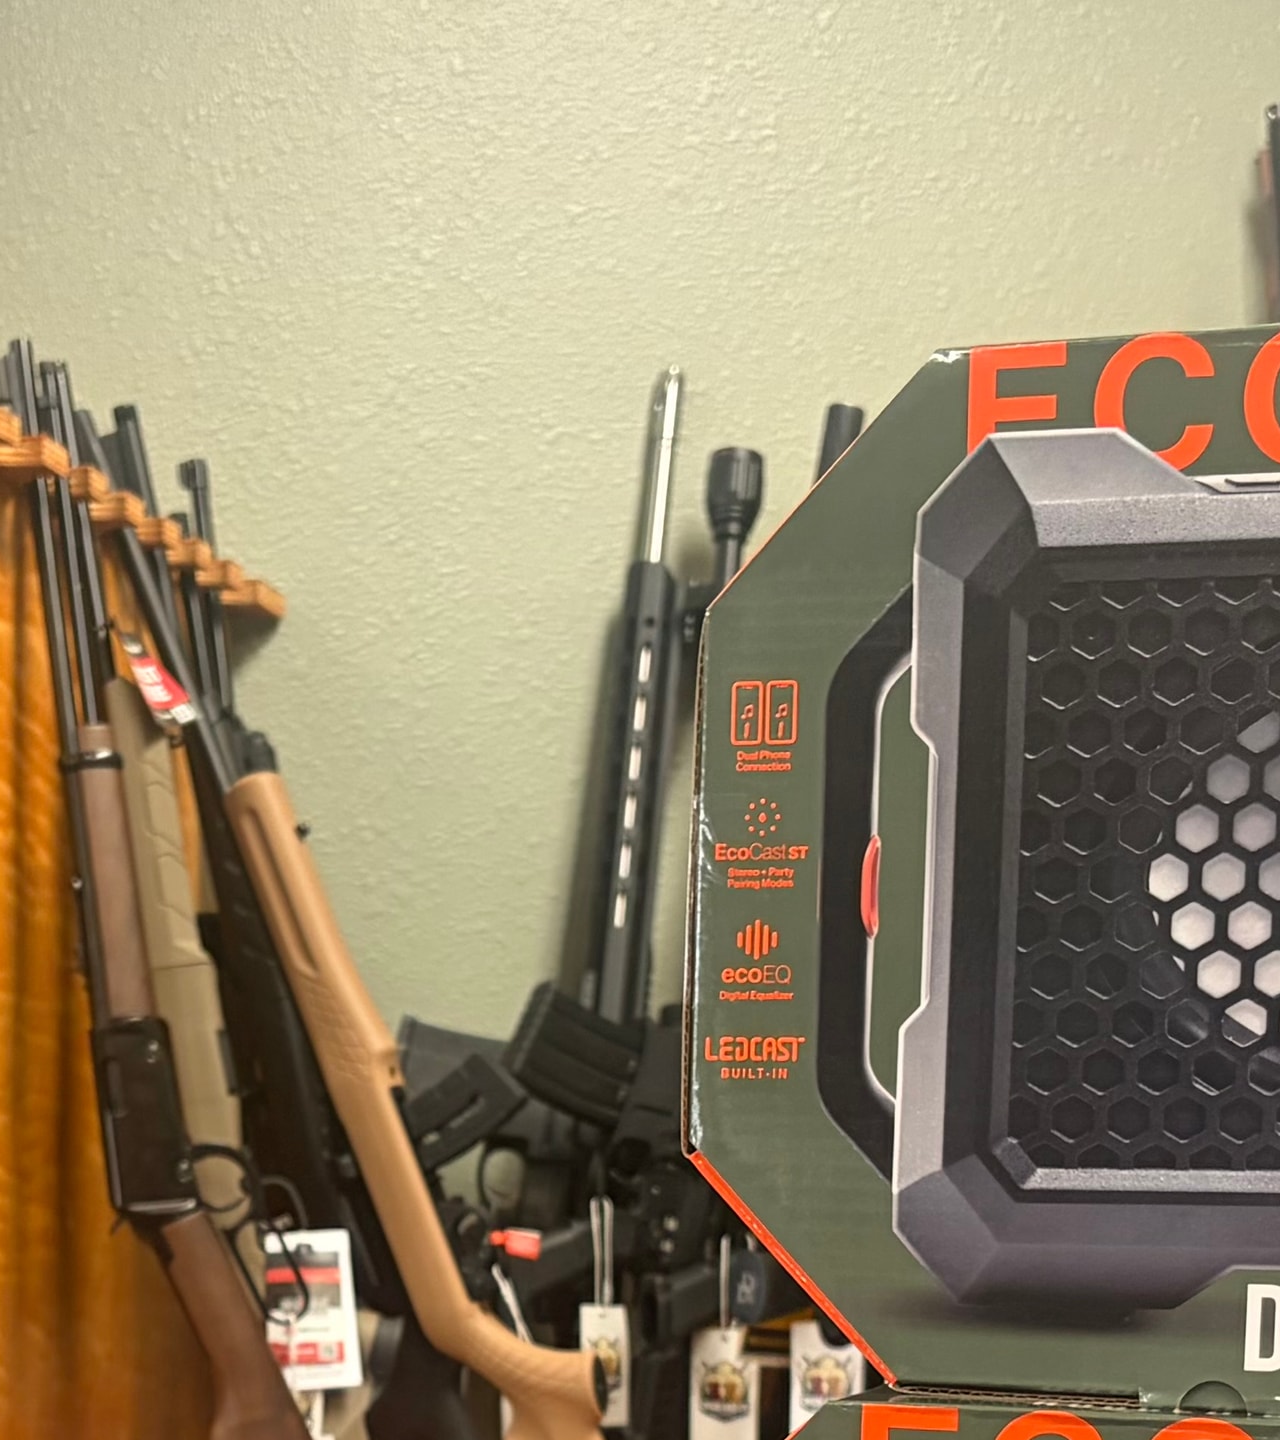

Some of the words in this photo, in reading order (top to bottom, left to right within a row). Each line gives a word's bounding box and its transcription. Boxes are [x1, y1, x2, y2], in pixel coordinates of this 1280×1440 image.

[759, 750, 792, 761] Phone
[735, 761, 792, 772] Connection
[727, 867, 760, 878] Stereo
[768, 866, 795, 879] Party
[727, 878, 760, 890] Pairing
[761, 878, 794, 889] Modes
[721, 964, 792, 984] ecoEQ
[719, 990, 749, 1002] Digital
[750, 990, 794, 1001] Equalizer
